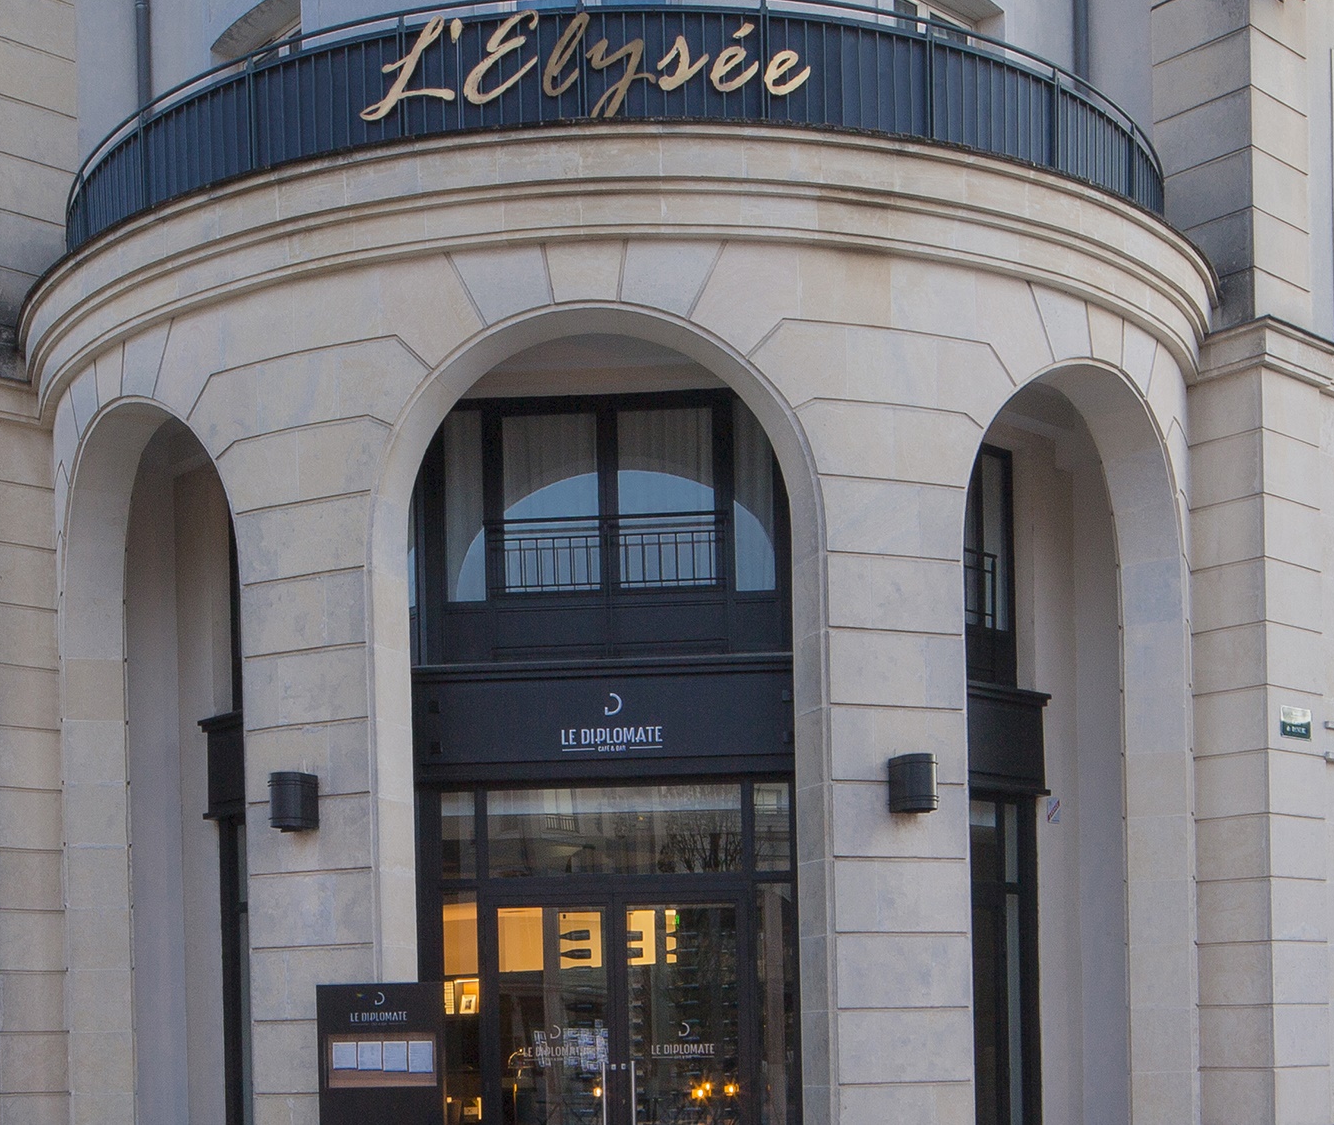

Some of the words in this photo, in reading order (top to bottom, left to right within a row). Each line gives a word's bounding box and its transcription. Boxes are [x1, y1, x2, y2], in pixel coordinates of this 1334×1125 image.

[359, 9, 812, 122] L'Elysée
[561, 728, 577, 745] LE
[580, 725, 664, 744] DIPLOMATE
[350, 1012, 360, 1022] LE
[361, 1010, 408, 1022] DIPLOMATE
[651, 1044, 661, 1055] LE
[663, 1043, 715, 1055] DIPLOMATE
